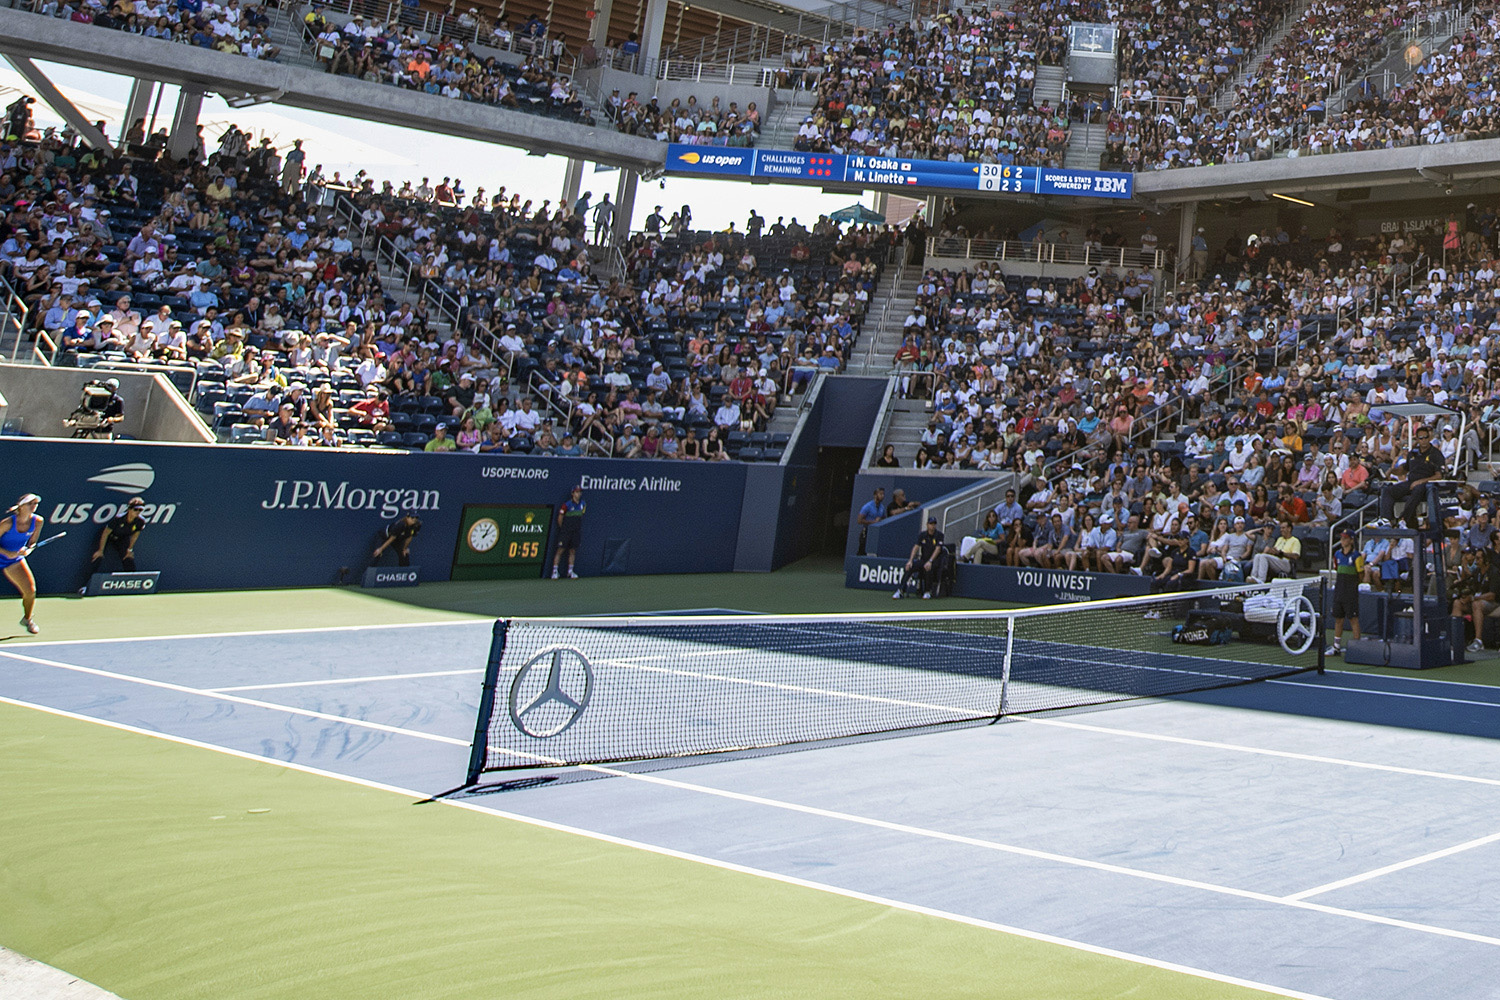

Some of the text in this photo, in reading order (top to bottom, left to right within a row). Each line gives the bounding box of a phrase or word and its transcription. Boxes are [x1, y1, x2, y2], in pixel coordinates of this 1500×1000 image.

[702, 154, 742, 166] us open
[761, 154, 805, 165] CHALLENGES
[764, 165, 801, 175] REMAINING
[856, 156, 866, 169] N.
[869, 158, 899, 170] Osaka
[983, 165, 998, 177] 30
[1003, 166, 1011, 178] 6
[1015, 167, 1023, 179] 2
[854, 170, 1022, 192] M. Linette 0 2 3
[1045, 174, 1068, 183] SCORES
[1074, 176, 1092, 184] STATS
[1094, 176, 1128, 194] IBM
[1054, 182, 1082, 190] POWERED
[1381, 220, 1408, 233] GRAD
[482, 467, 549, 480] USOPEN.ORG
[580, 475, 681, 491] Emirates Airline
[262, 480, 440, 519] J.P.Morgan
[50, 503, 93, 524] us
[511, 524, 544, 533] ROLEX
[508, 541, 540, 558] 0:55
[376, 572, 408, 582] CHASE
[859, 564, 917, 587] Deloitt.
[1017, 571, 1093, 592] YOU INVEST
[102, 580, 142, 590] CHASE
